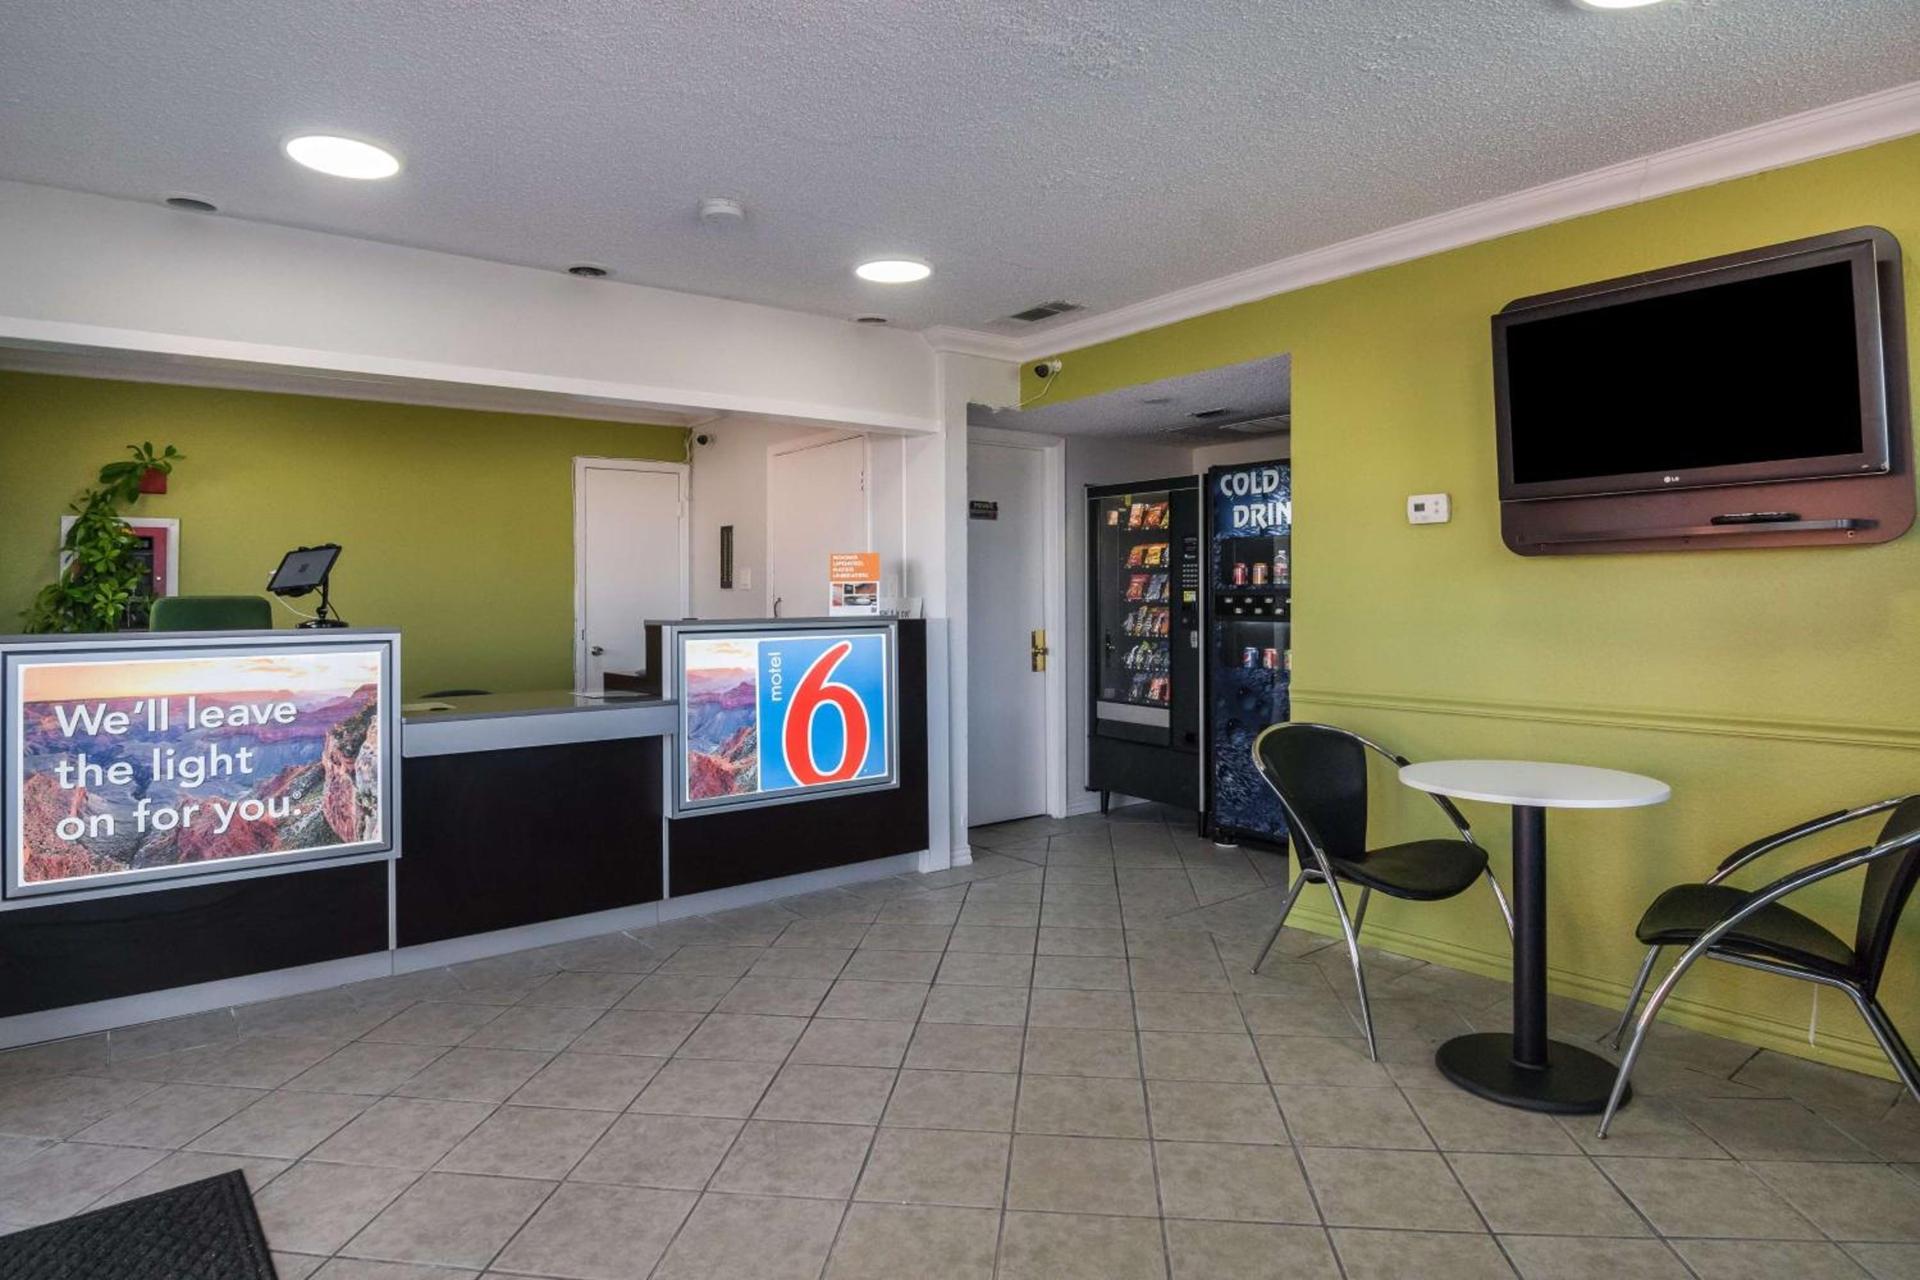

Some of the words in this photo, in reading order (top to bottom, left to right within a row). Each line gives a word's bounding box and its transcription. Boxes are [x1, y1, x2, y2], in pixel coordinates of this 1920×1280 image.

[1220, 469, 1280, 497] COLD
[54, 697, 169, 738] We'll
[188, 696, 297, 730] leave
[768, 651, 783, 702] motel
[781, 640, 871, 787] 6
[54, 753, 134, 790] the
[152, 743, 254, 788] light
[55, 812, 116, 841] on
[133, 797, 200, 833] for
